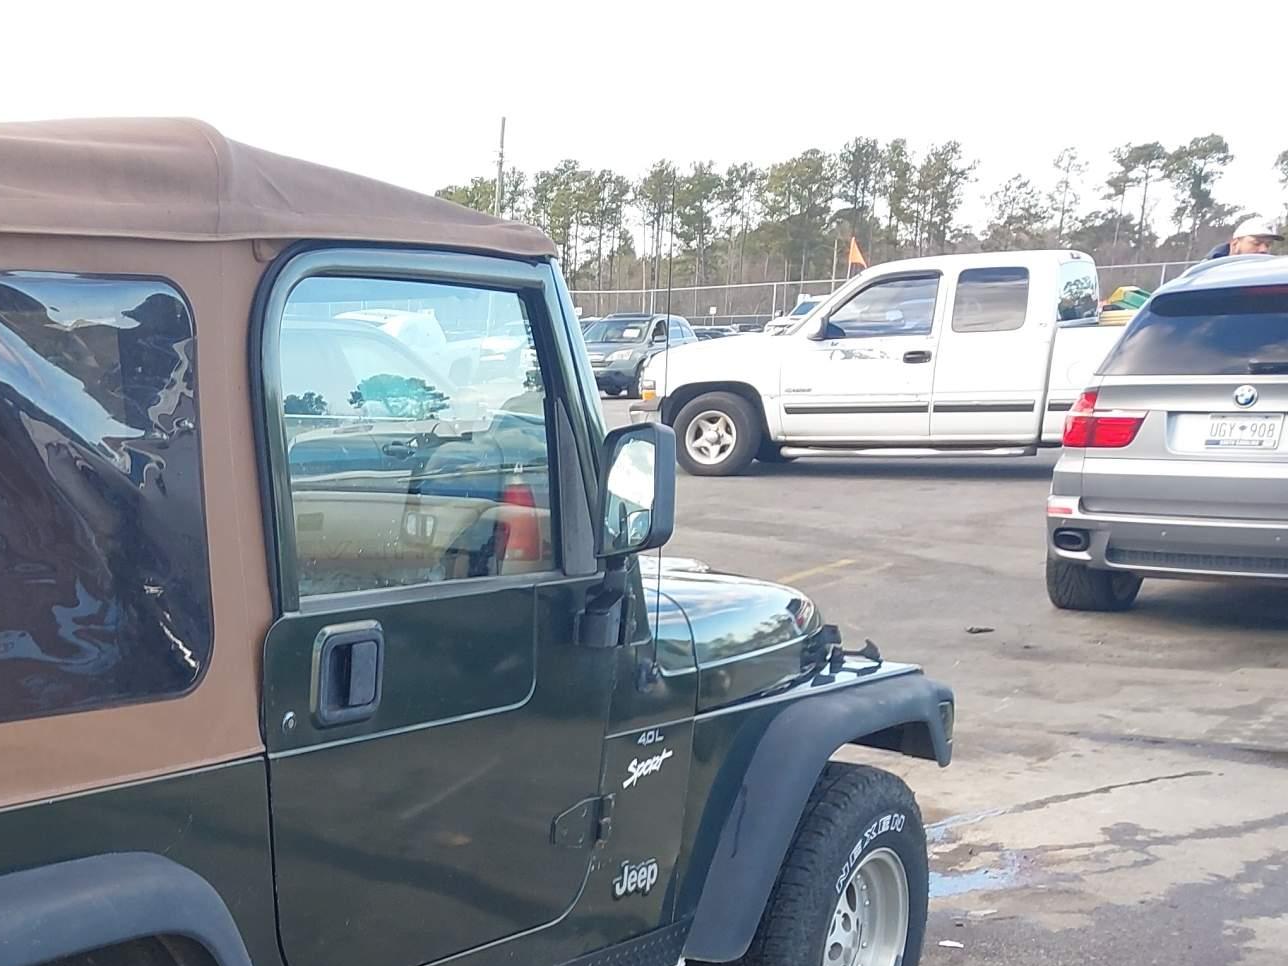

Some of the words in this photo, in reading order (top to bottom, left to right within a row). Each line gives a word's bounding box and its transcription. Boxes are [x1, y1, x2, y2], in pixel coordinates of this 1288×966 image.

[1210, 422, 1237, 437] UGY
[1250, 423, 1276, 438] 908
[622, 748, 673, 790] Sport
[835, 813, 906, 894] NEXEN
[614, 862, 659, 896] Jeep
